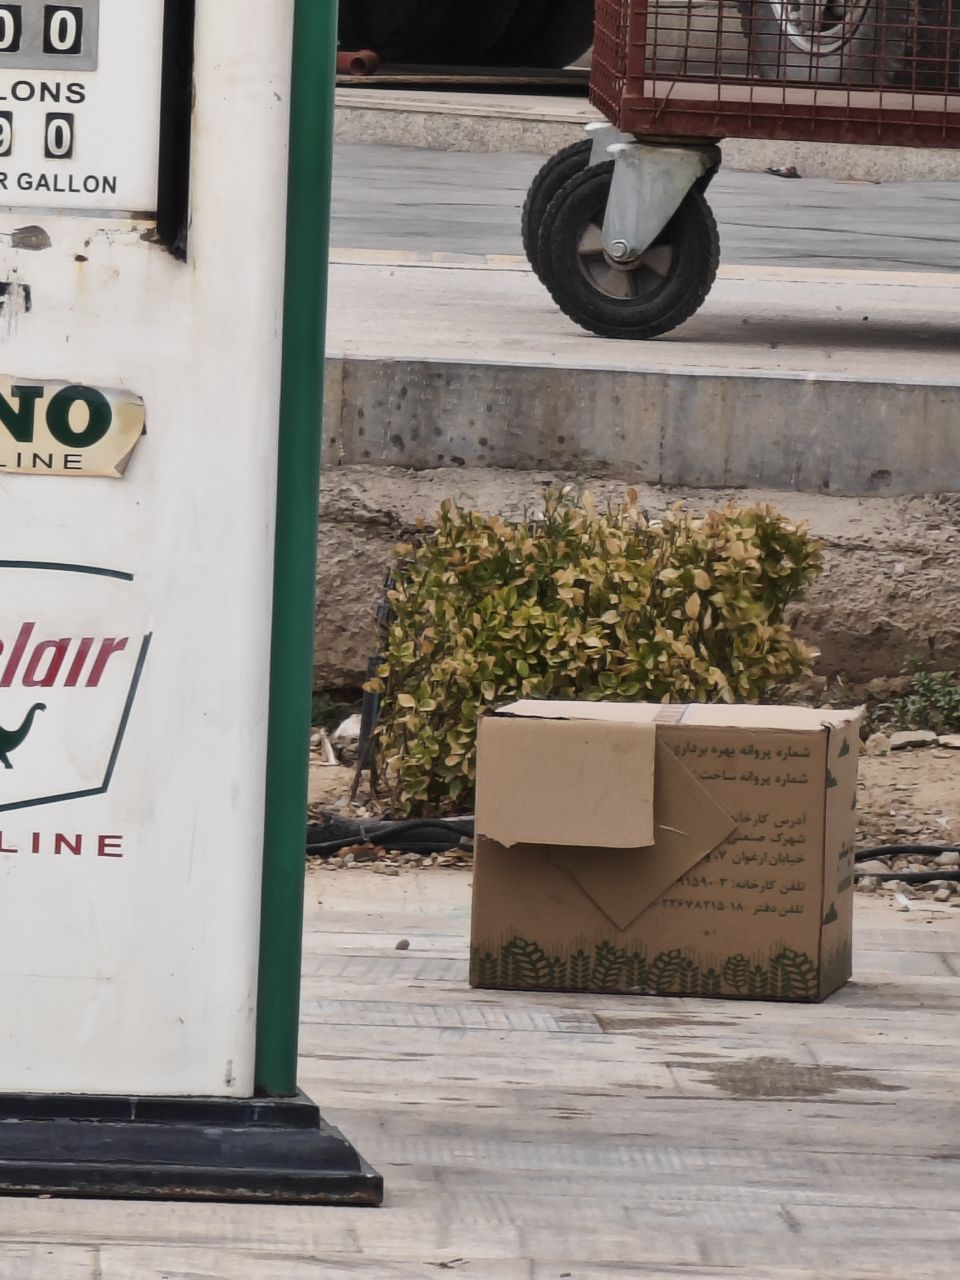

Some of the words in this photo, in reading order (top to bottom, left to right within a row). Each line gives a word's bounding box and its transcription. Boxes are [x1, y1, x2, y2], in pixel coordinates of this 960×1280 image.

[17, 172, 117, 194] GALLON
[739, 744, 771, 760] پروانه
[776, 745, 810, 760] شماره
[739, 771, 771, 786] پروانه
[774, 772, 808, 786] شماره
[774, 812, 807, 828] آدرس
[770, 832, 806, 846] شهرک
[779, 880, 806, 895] تلفن
[778, 903, 804, 917] تلفن
